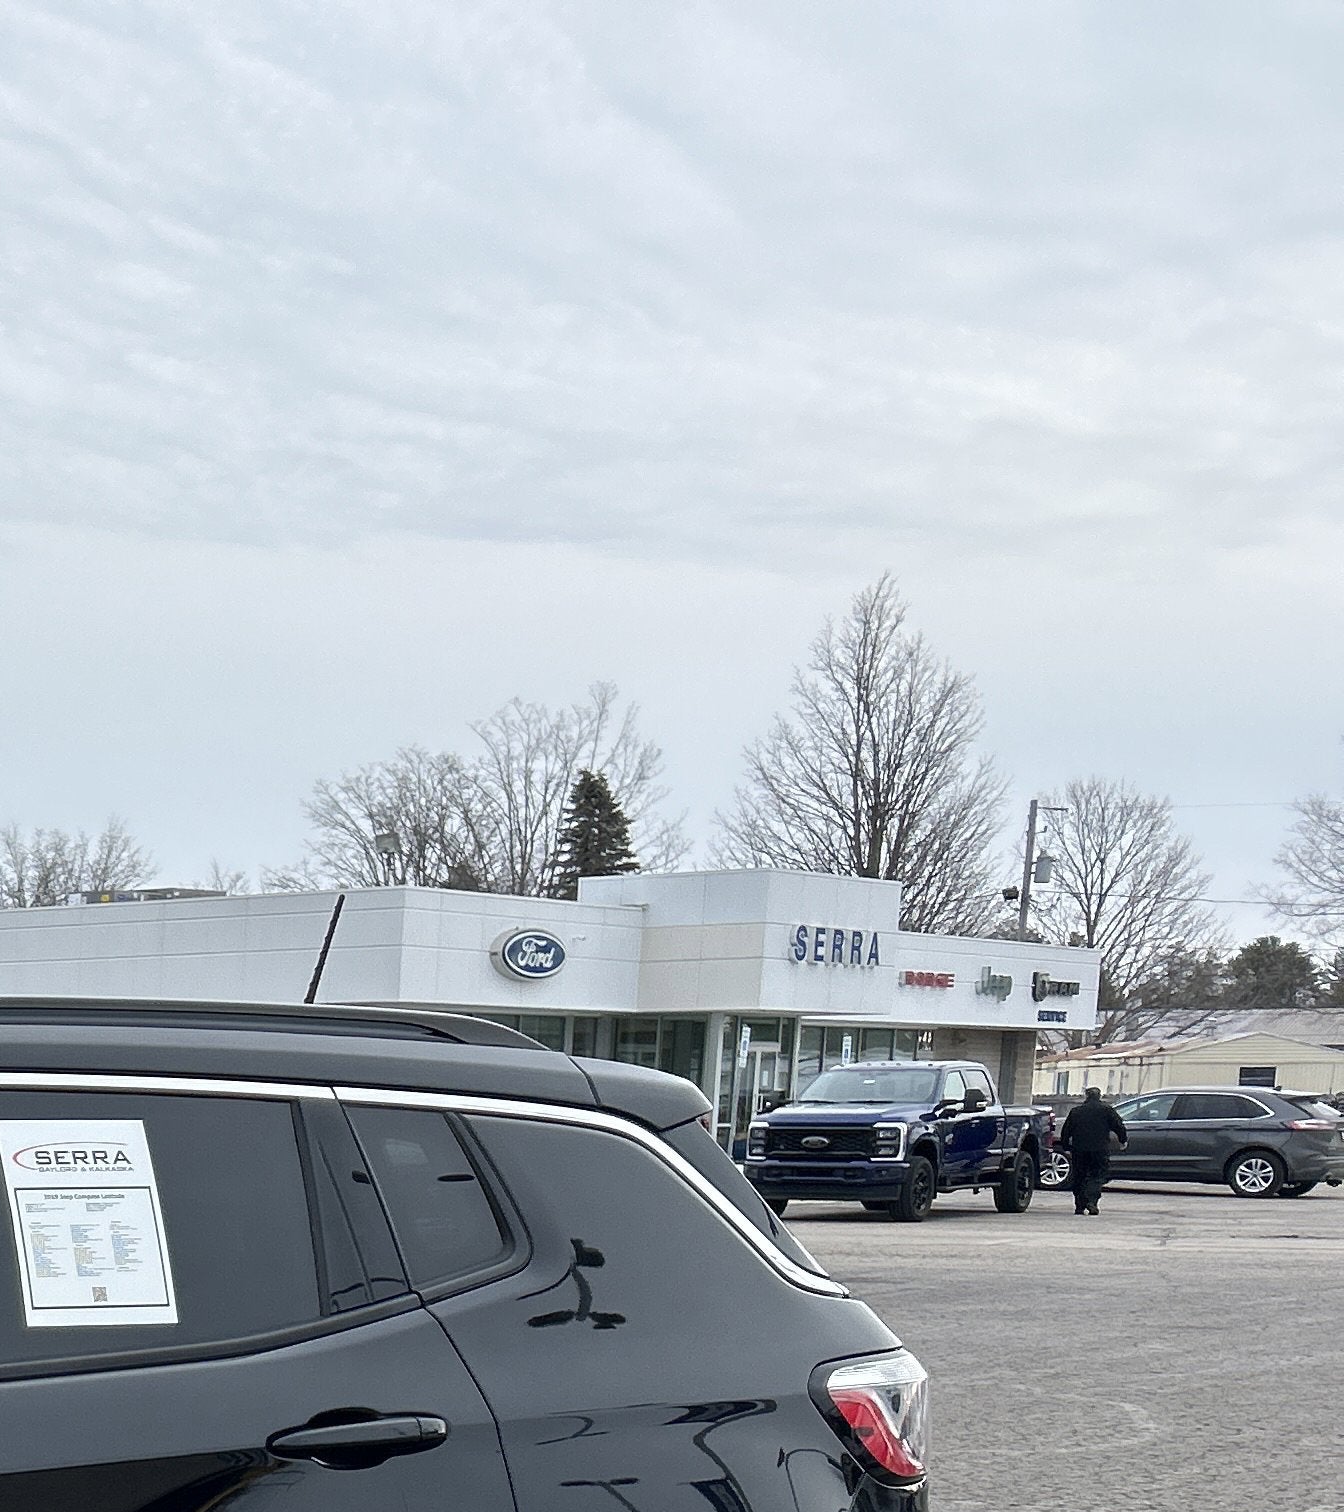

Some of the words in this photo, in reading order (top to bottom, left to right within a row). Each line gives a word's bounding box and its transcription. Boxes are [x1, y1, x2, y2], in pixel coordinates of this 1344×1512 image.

[517, 937, 556, 968] Ford
[794, 925, 880, 966] SERRA
[34, 1150, 133, 1165] SERRA
